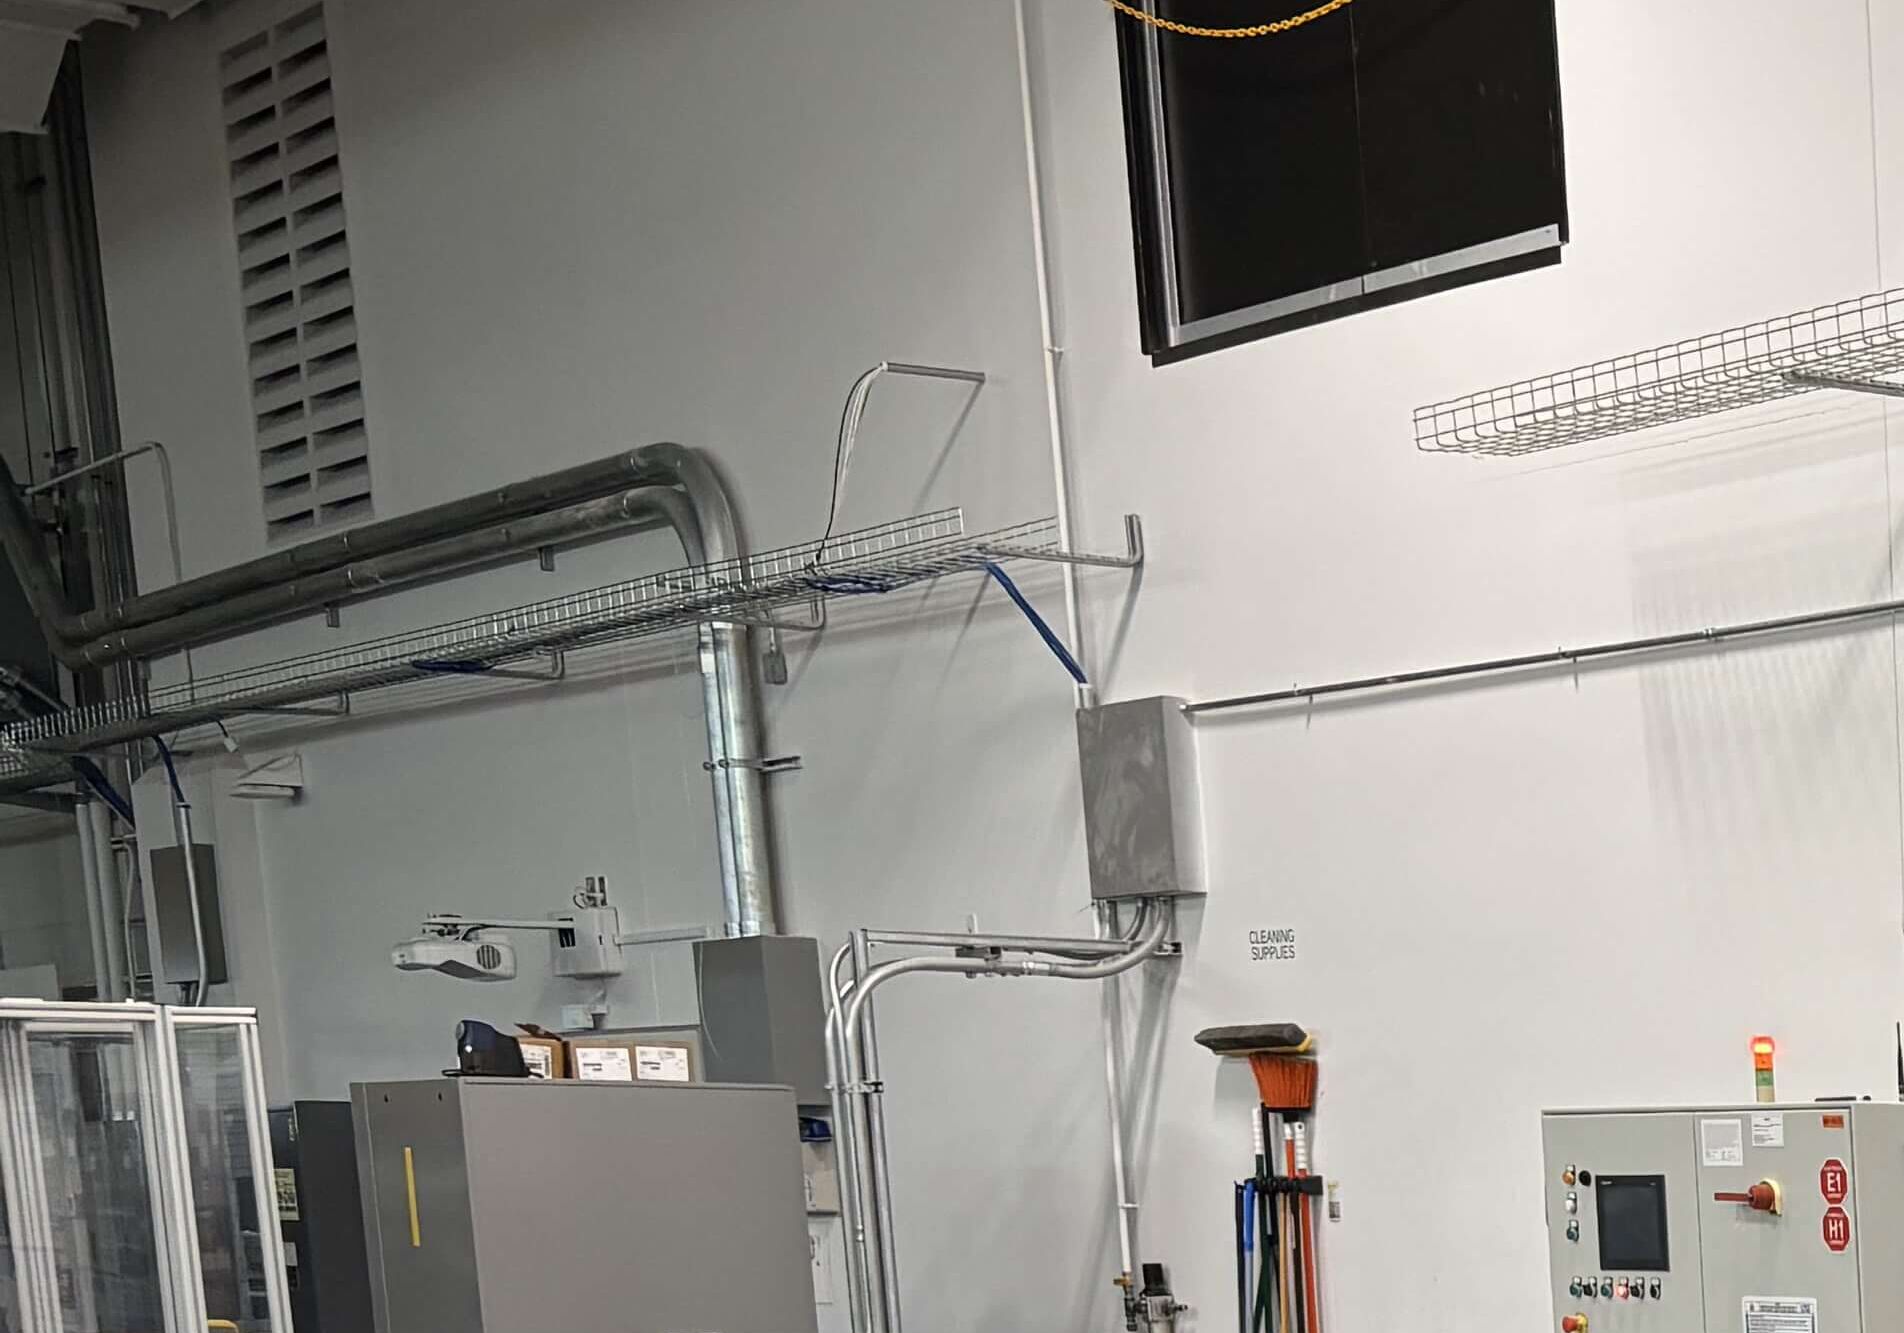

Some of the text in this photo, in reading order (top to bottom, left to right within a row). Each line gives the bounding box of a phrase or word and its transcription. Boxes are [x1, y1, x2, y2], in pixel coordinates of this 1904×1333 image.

[1249, 929, 1295, 944] CLEANING
[1251, 945, 1295, 961] SUPPLIES
[1827, 1172, 1841, 1192] E1
[1829, 1219, 1844, 1239] H1
